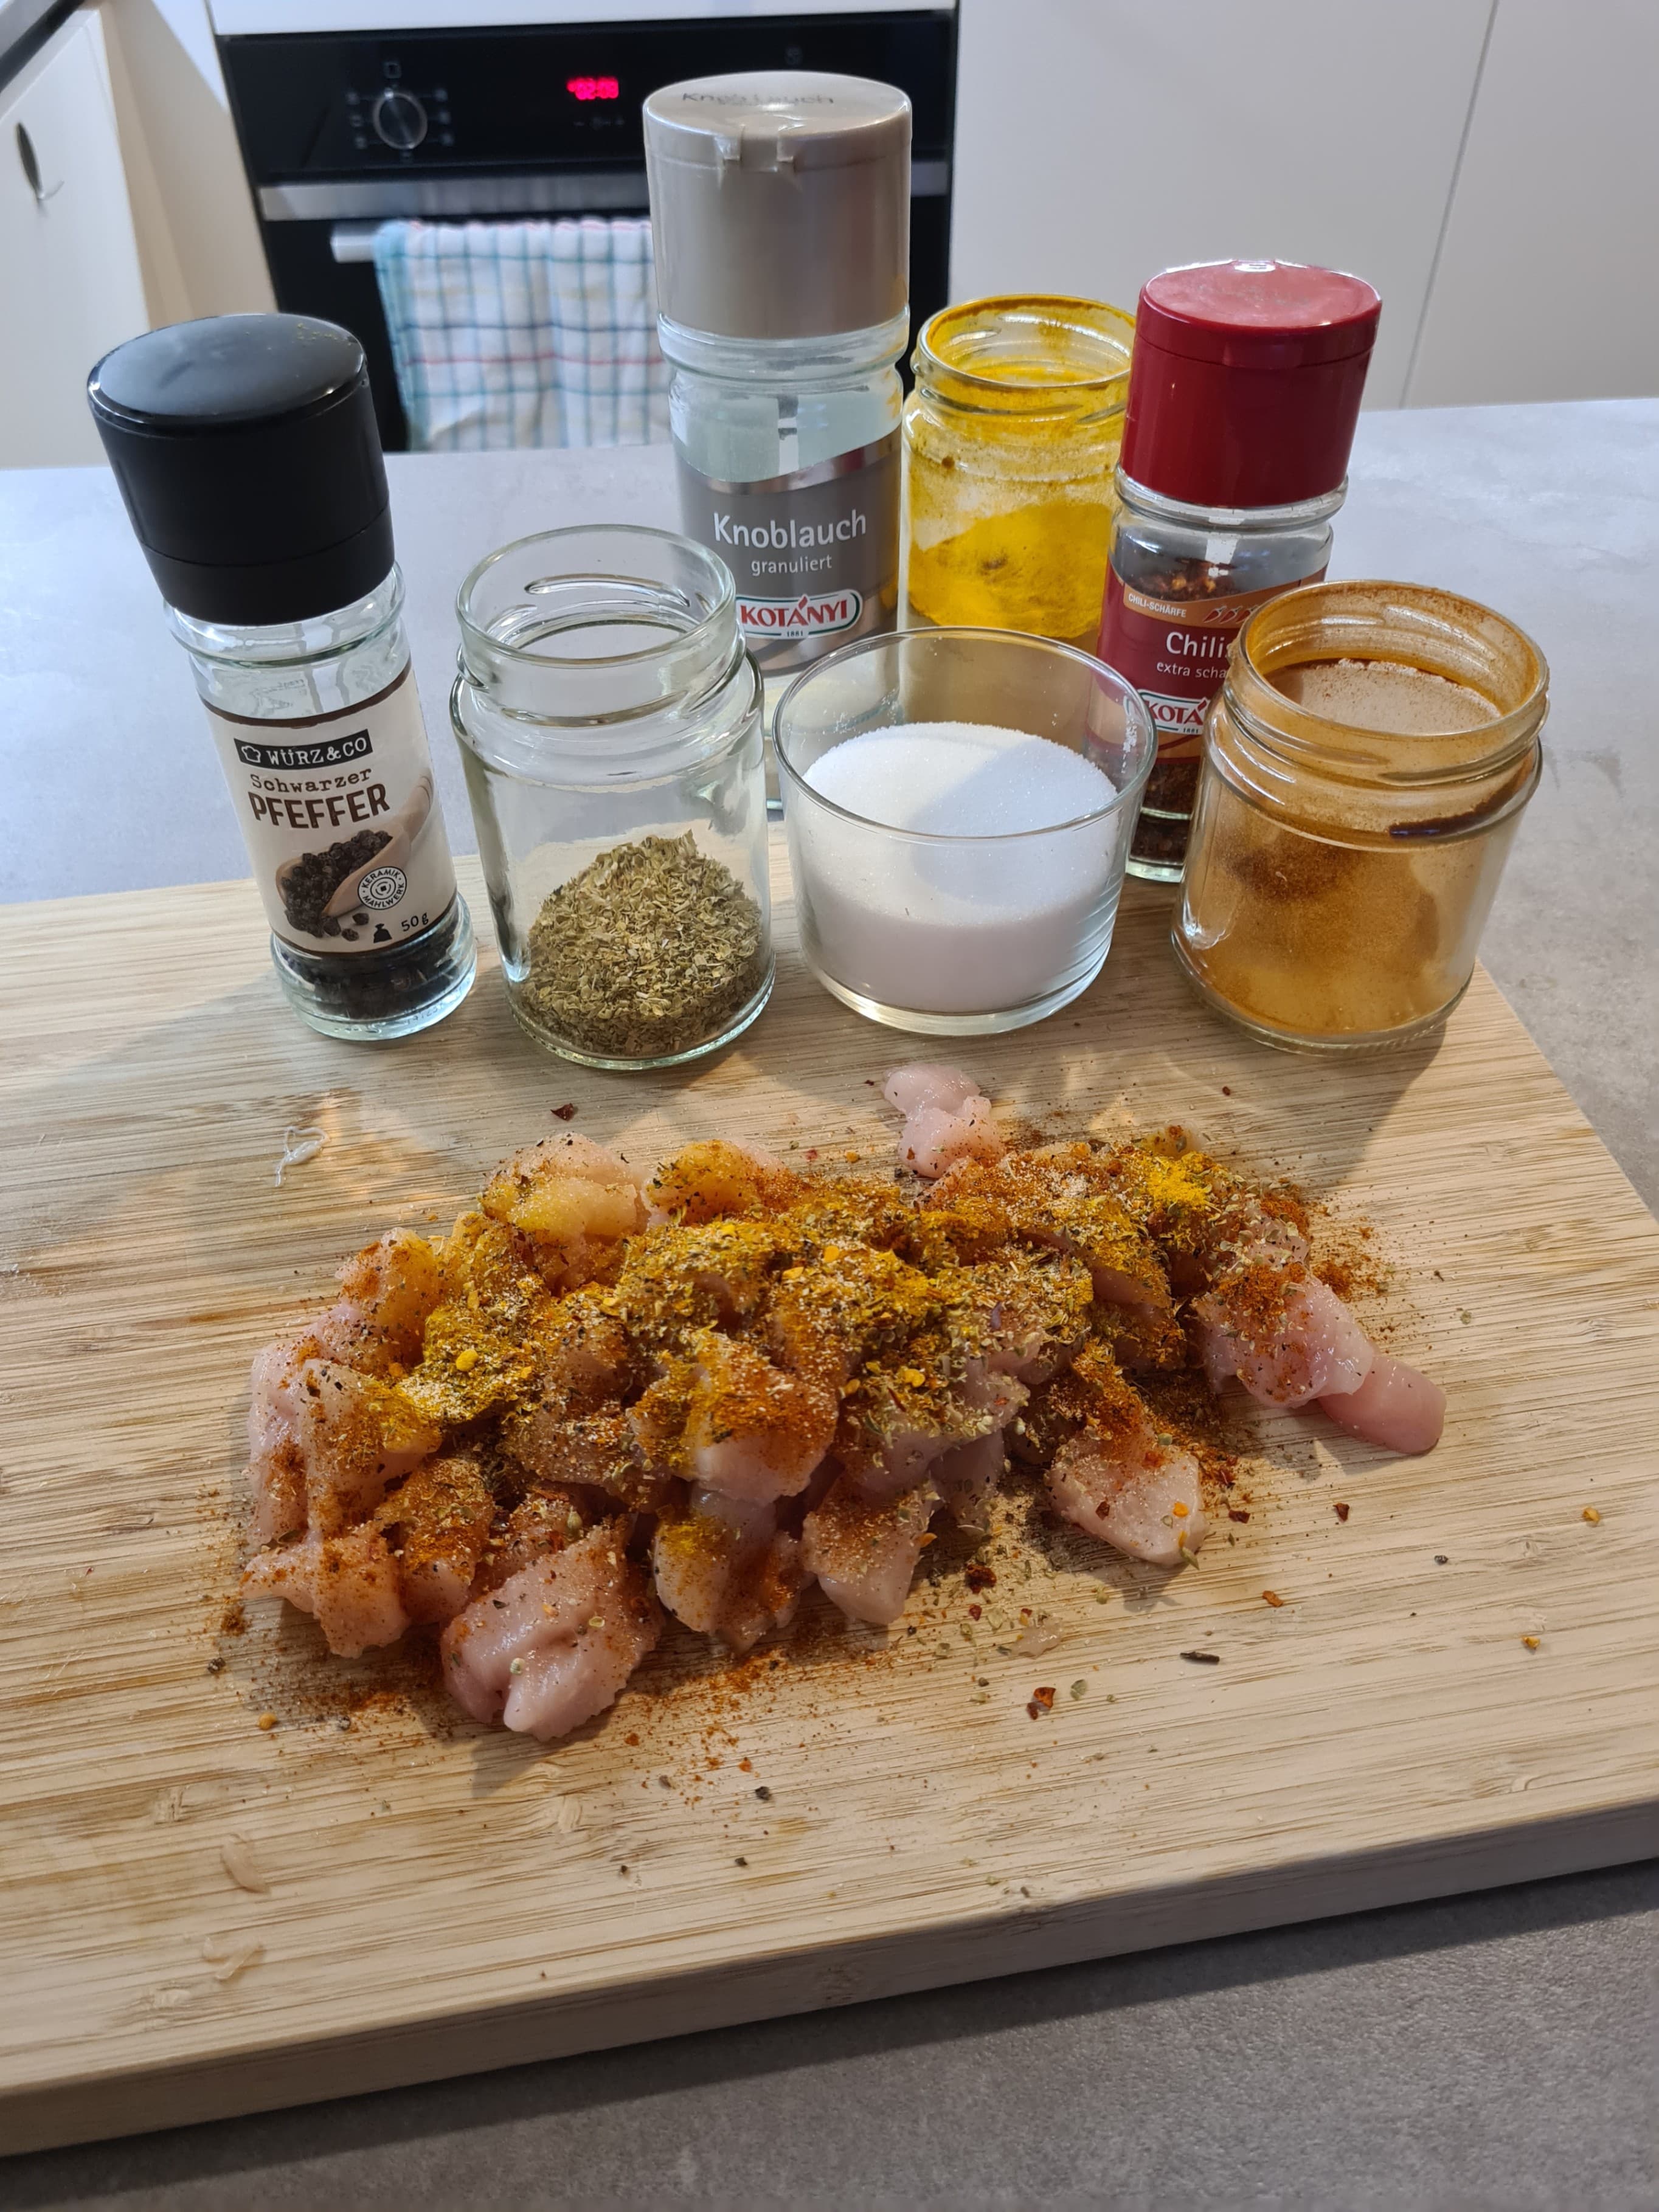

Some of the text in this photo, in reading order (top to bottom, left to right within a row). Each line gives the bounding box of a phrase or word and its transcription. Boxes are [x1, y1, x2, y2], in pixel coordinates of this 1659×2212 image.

[713, 509, 866, 548] Knoblauch
[751, 554, 833, 576] granuliert
[739, 596, 848, 627] KOTÁNYI
[1128, 593, 1186, 618] CHILI-SCHÄRFE
[1166, 632, 1227, 658] Chili
[1157, 660, 1227, 679] extra scha
[1145, 700, 1207, 725] KOTÁ
[266, 738, 367, 766] WÜRZ&CO
[250, 767, 372, 793] Schwarzer
[248, 783, 390, 829] PFEFFER
[362, 869, 400, 888] KERAMIK
[362, 883, 404, 908] MAHLWERK
